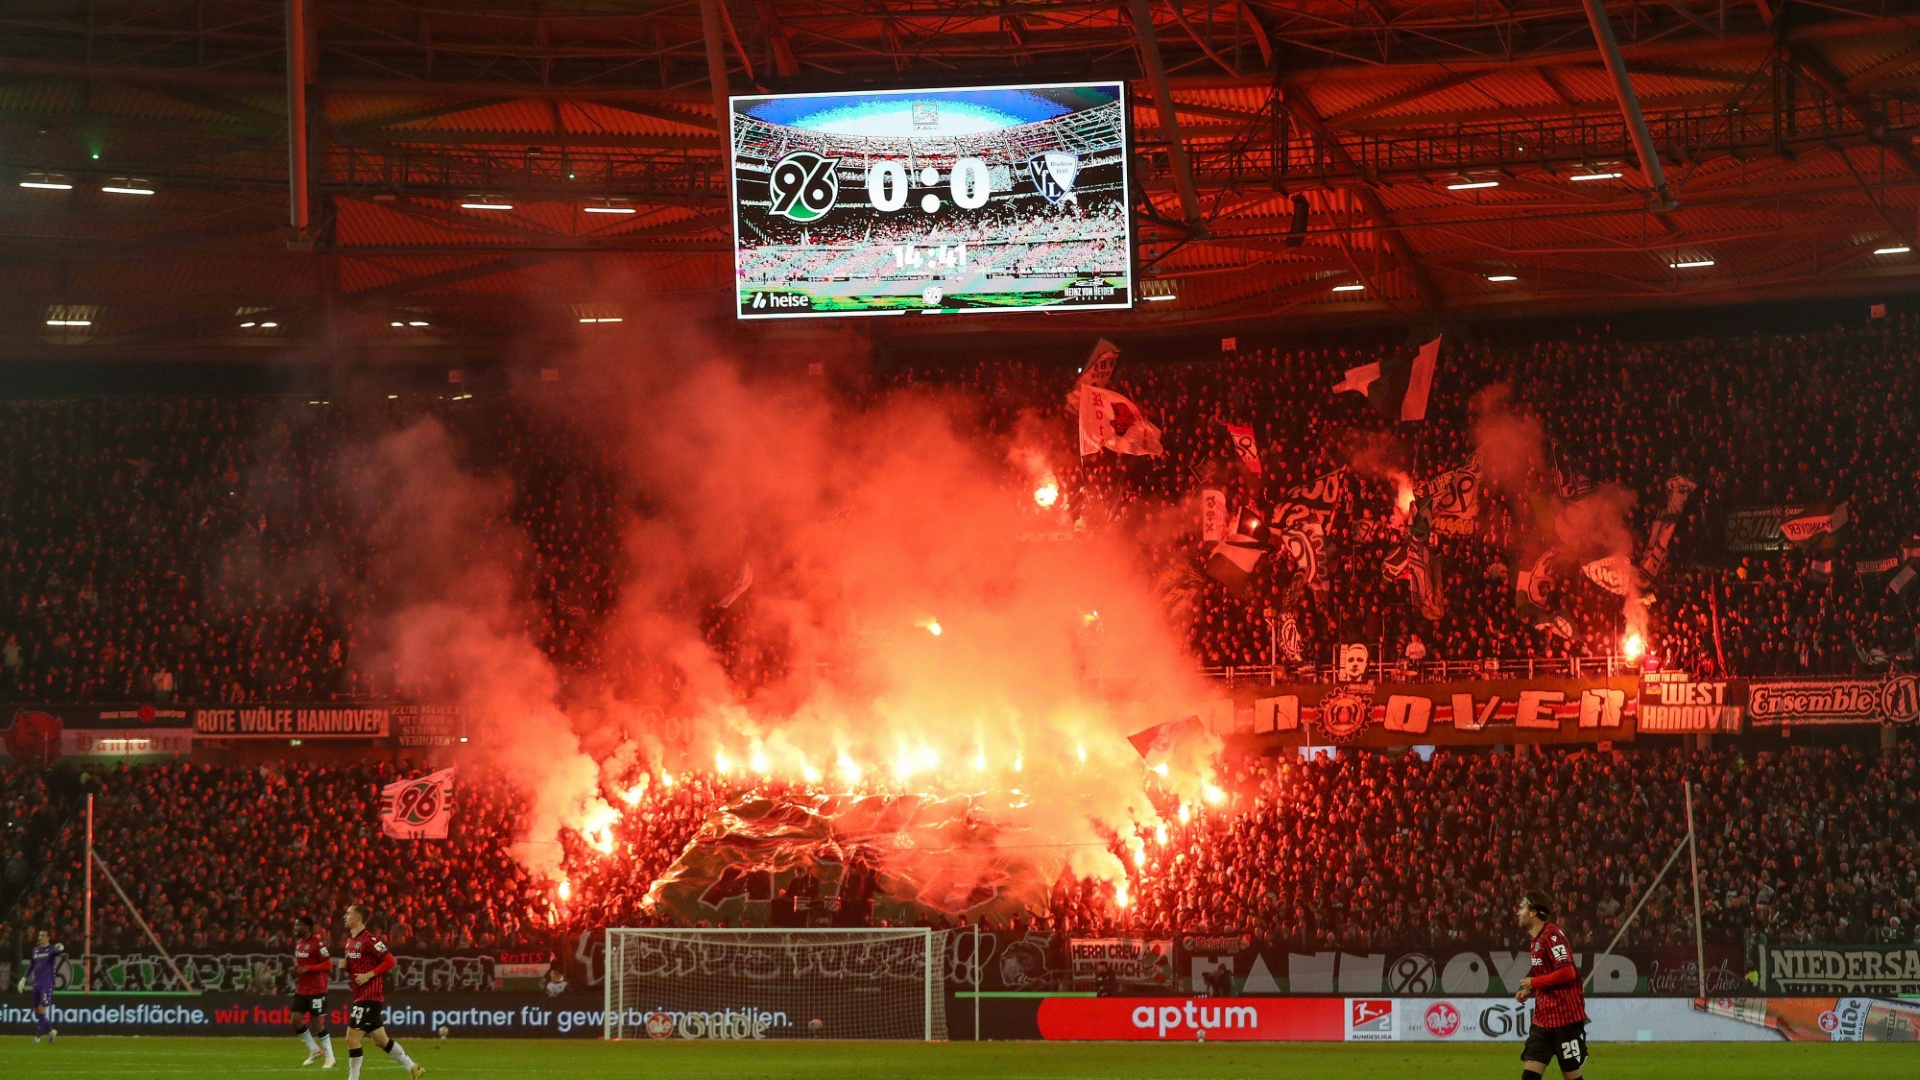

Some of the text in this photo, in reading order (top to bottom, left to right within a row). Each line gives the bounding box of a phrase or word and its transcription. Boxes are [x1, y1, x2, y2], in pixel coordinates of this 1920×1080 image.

[770, 158, 839, 213] 96
[770, 292, 808, 308] heise
[1661, 682, 1726, 704] WEST
[1753, 685, 1873, 714] Ensemble
[199, 709, 235, 732] ROTE
[1108, 944, 1140, 959] CREW
[214, 1004, 249, 1024] wir
[381, 1006, 425, 1025] dein
[432, 1007, 513, 1031] partner
[521, 1006, 550, 1025] für
[1132, 1001, 1258, 1037] aptum
[1562, 1039, 1580, 1059] 29
